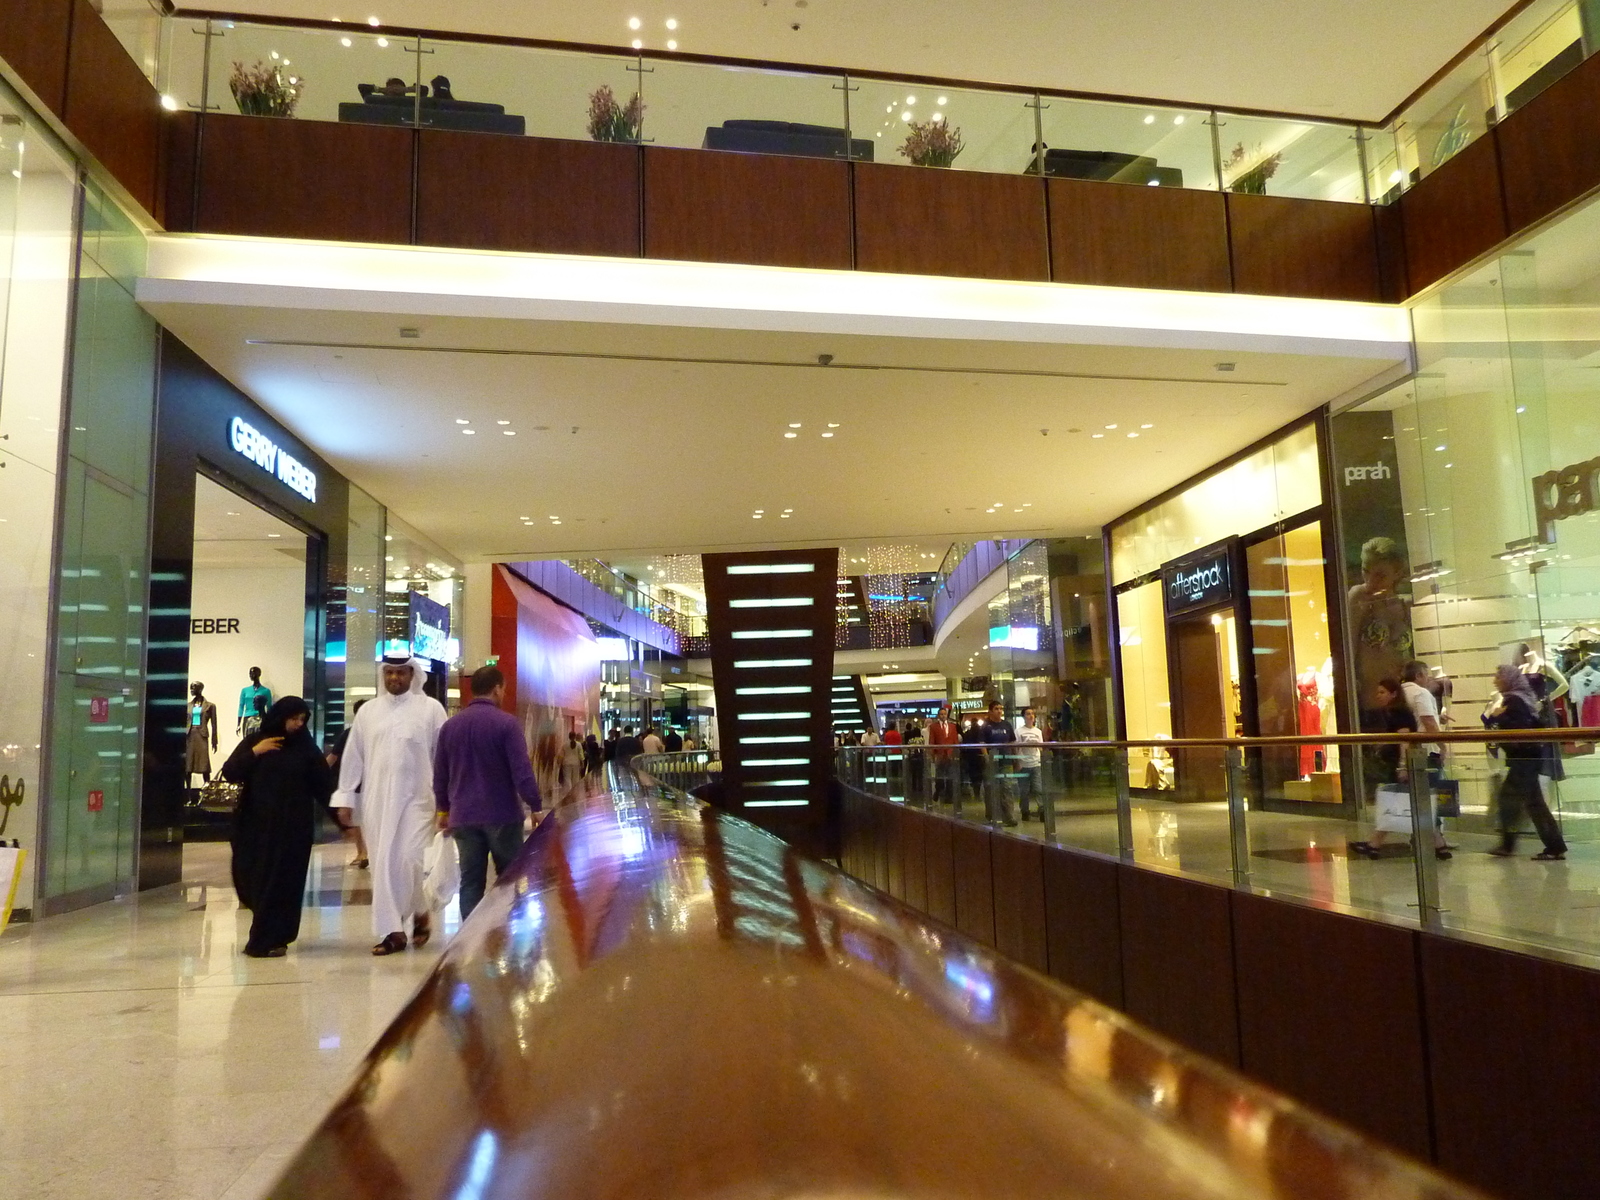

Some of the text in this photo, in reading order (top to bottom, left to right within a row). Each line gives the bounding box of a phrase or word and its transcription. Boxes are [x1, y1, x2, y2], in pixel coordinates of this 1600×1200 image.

[231, 416, 317, 504] GERRY WEBER
[1344, 461, 1391, 486] parah
[1170, 560, 1224, 599] aftershock
[190, 618, 240, 634] EBER
